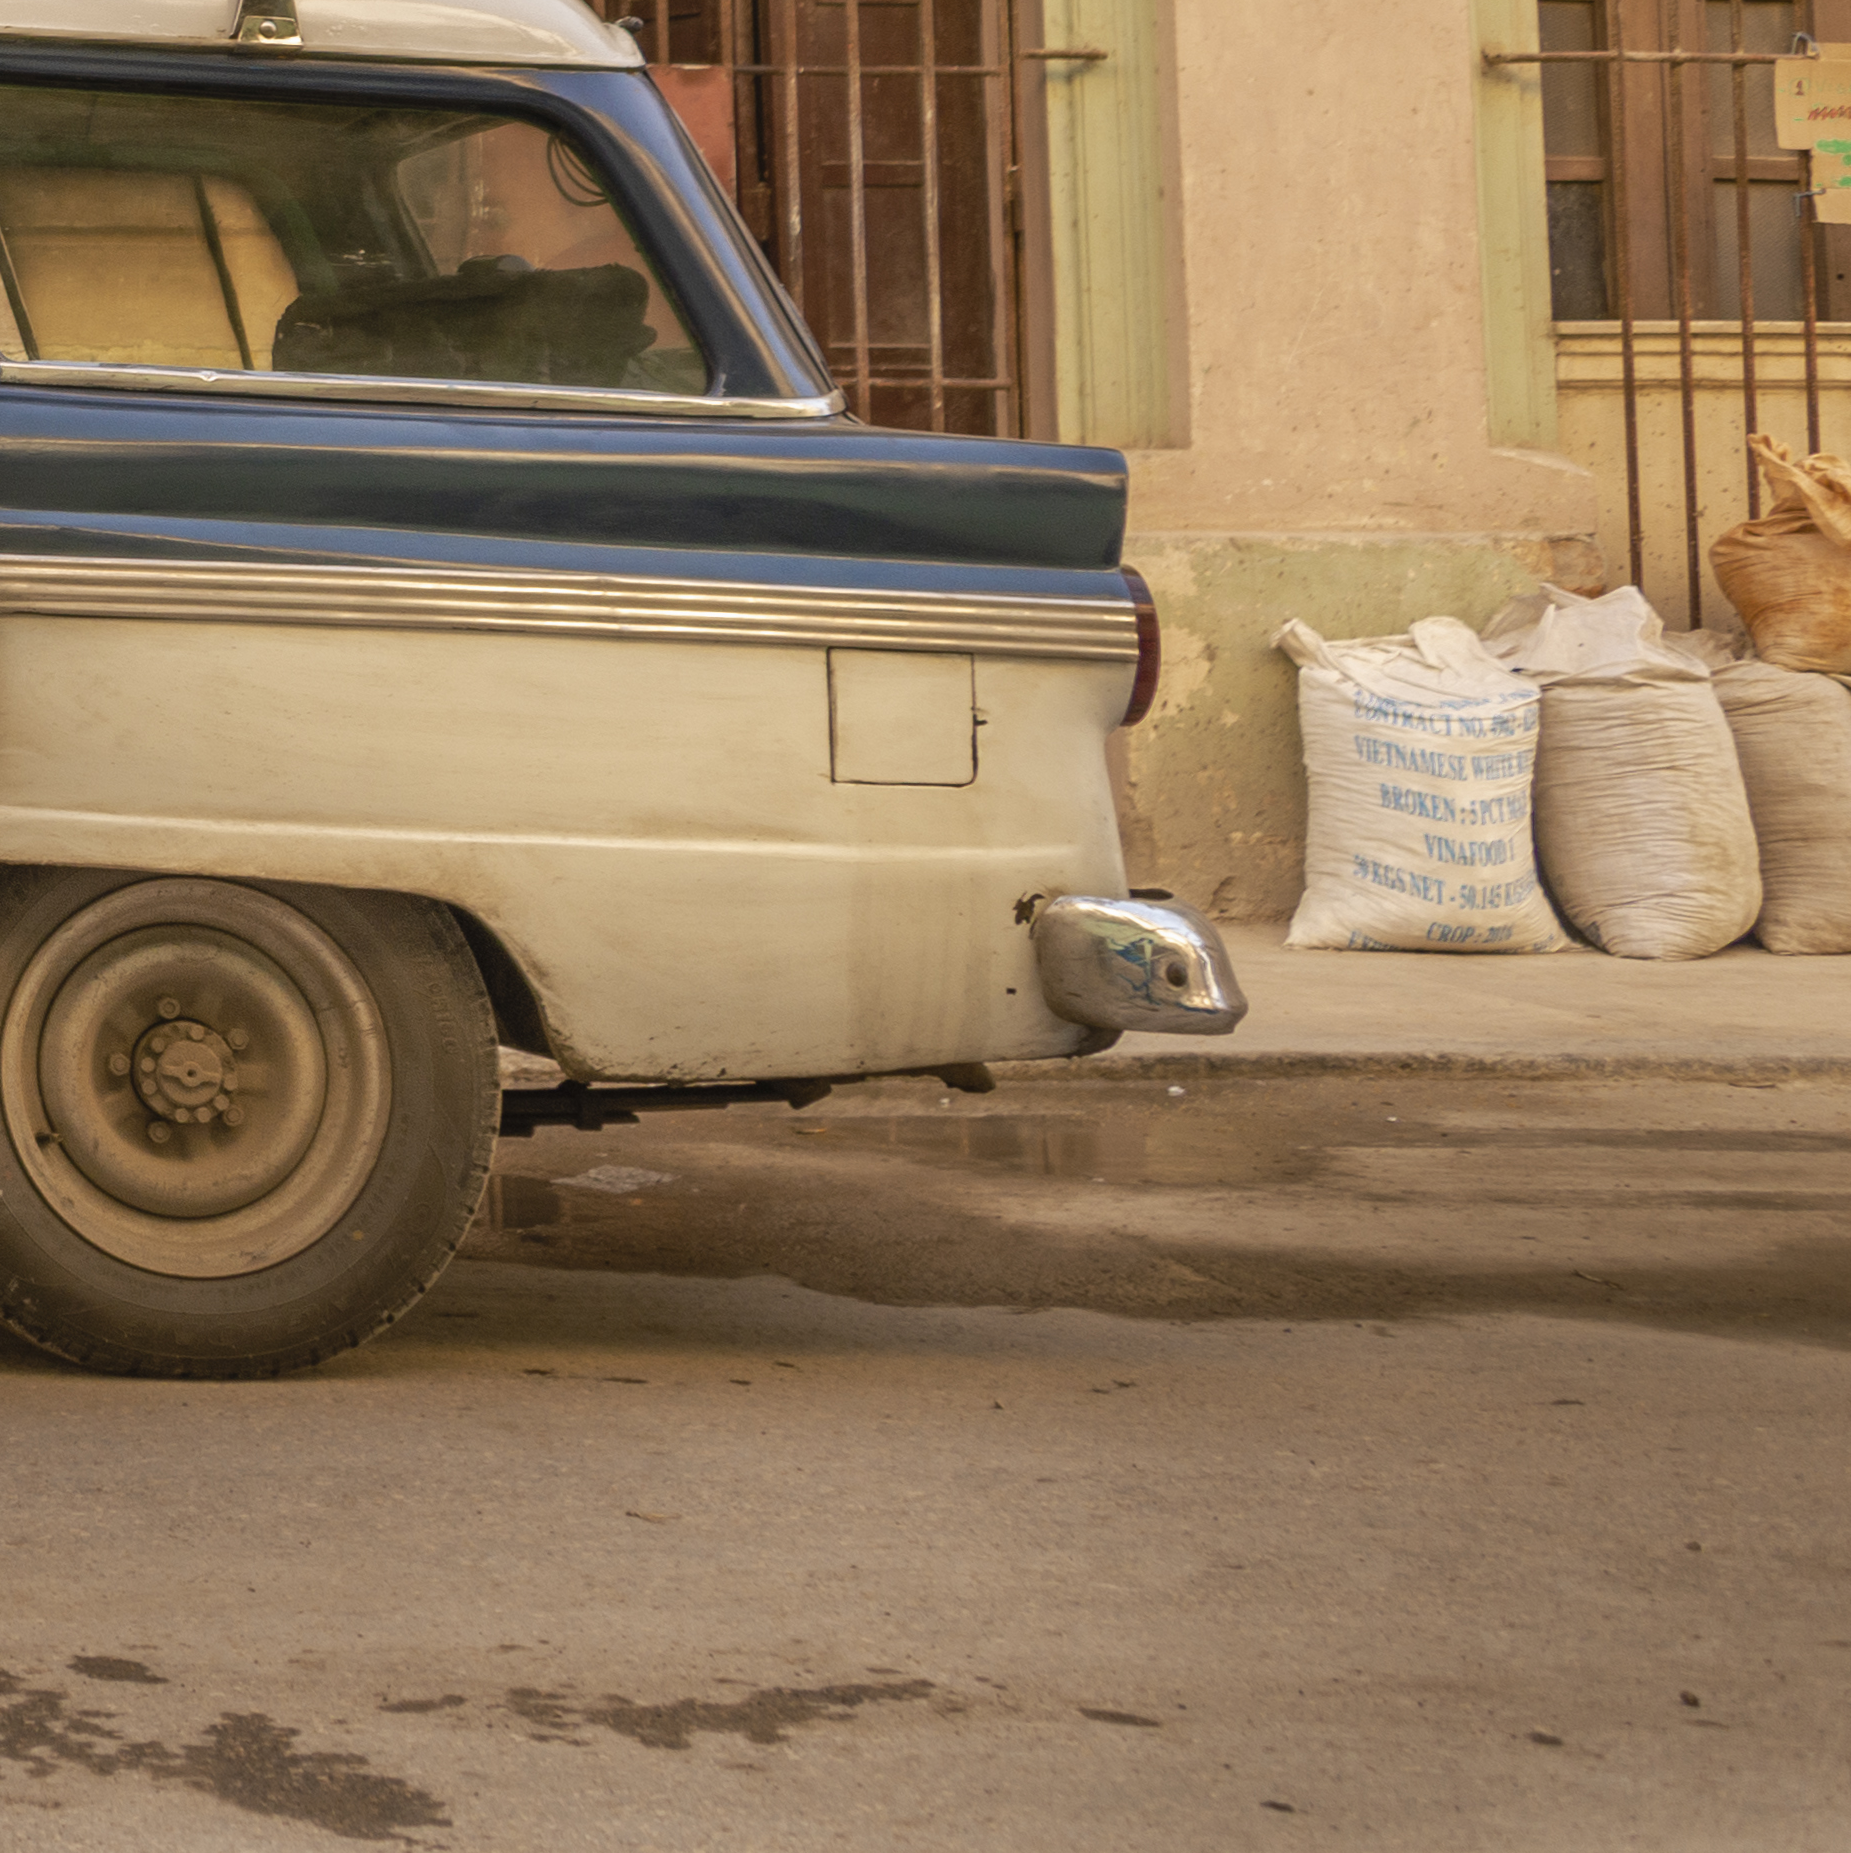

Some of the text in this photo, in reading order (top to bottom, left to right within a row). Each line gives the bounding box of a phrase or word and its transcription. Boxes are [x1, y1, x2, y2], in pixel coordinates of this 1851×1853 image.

[1354, 734, 1468, 782] VIETNAMESE
[1471, 753, 1514, 782] WHITE
[1379, 783, 1457, 823] BROKEN
[1480, 797, 1505, 826] PCT
[1424, 833, 1508, 867] VINAFOOD
[1370, 861, 1407, 894] KGS
[1409, 871, 1445, 905] NET
[1426, 921, 1475, 944] CROP
